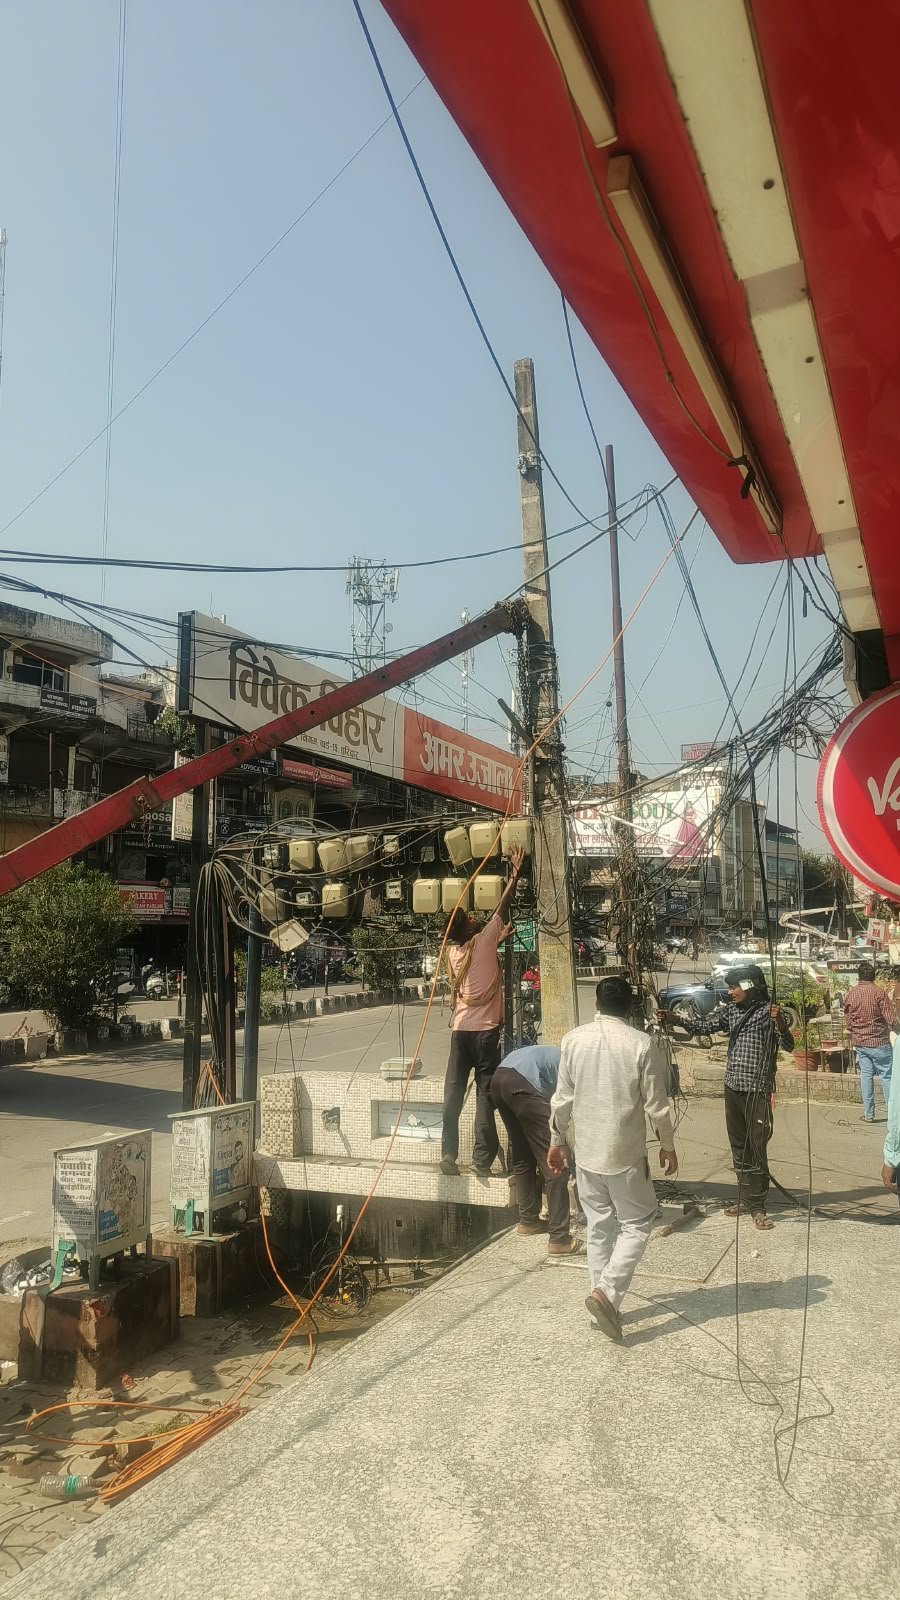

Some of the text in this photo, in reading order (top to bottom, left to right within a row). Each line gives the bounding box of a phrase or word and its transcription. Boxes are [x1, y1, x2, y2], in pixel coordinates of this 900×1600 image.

[229, 640, 311, 715] विवेक
[420, 731, 514, 799] अमर उजाला
[133, 892, 159, 900] AKERY
